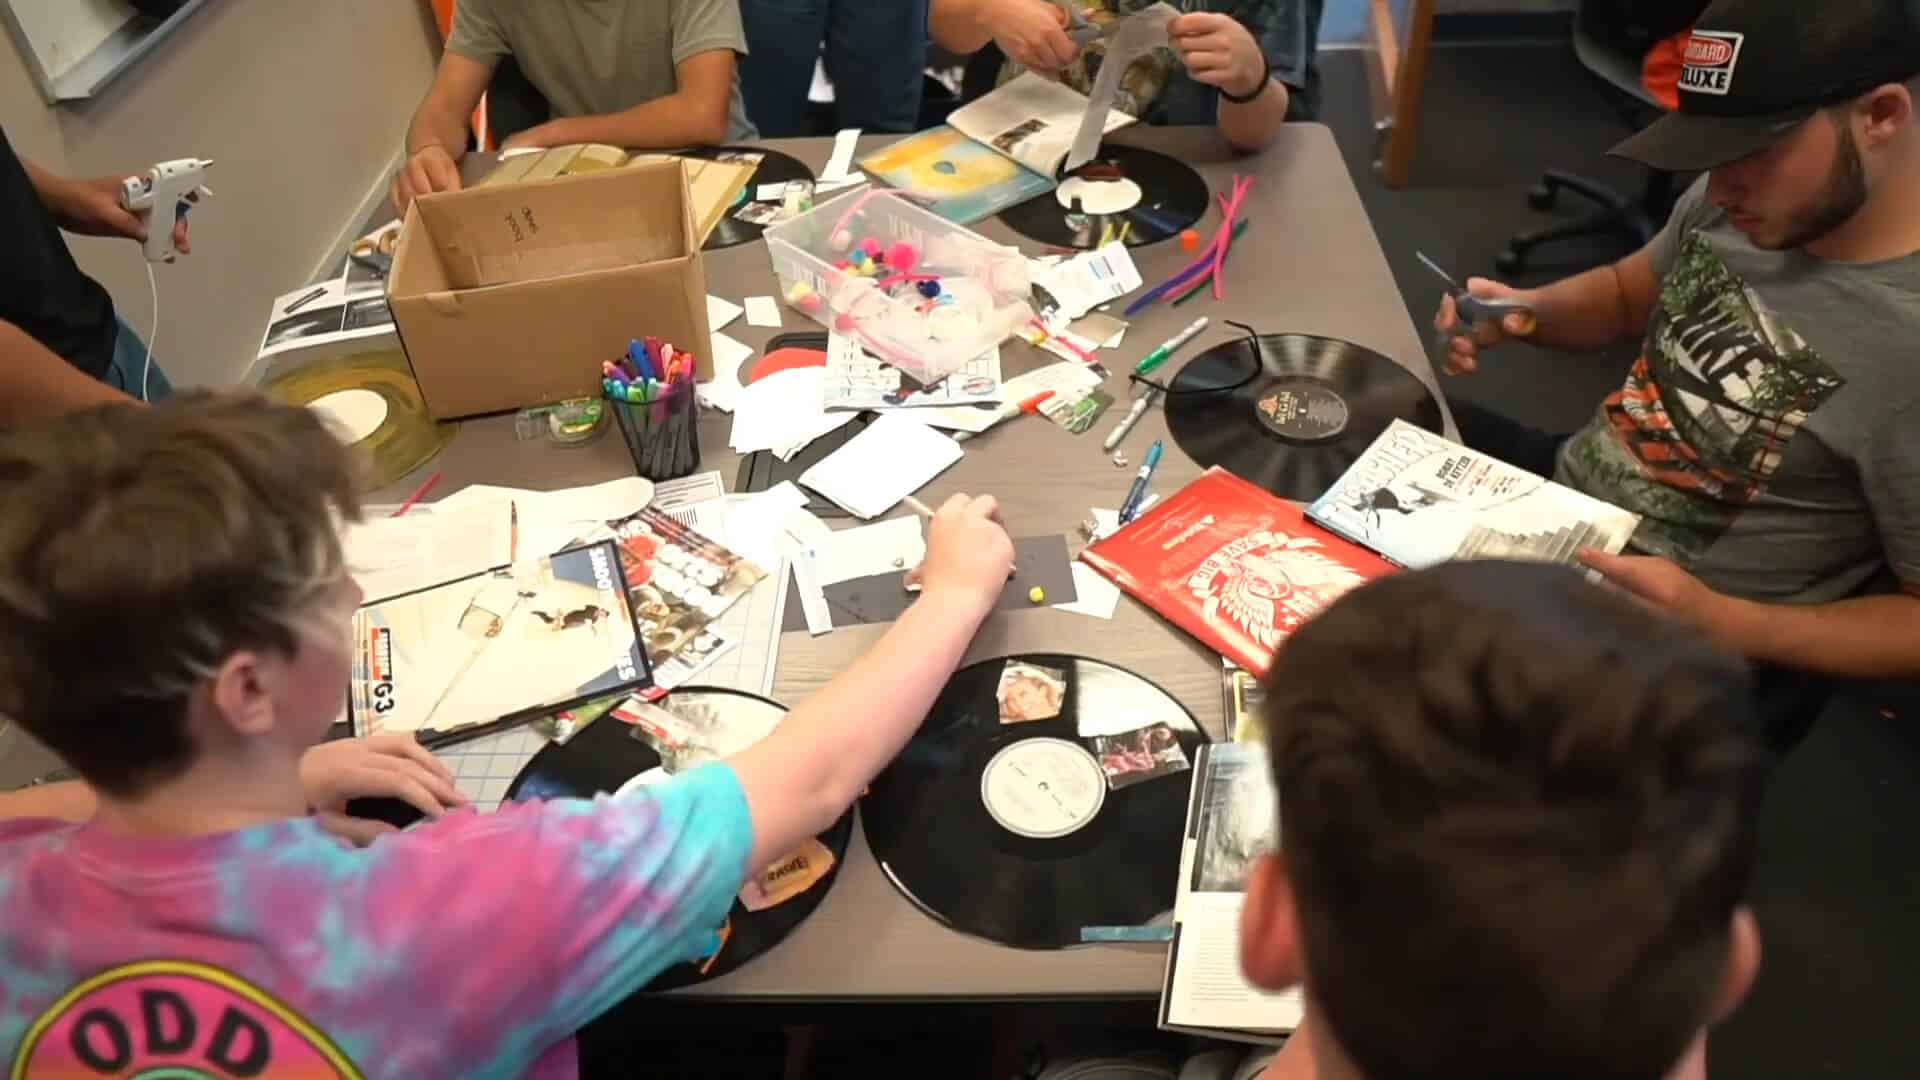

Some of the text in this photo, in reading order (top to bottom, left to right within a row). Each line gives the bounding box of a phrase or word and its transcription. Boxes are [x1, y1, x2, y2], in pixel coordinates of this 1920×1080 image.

[1681, 67, 1728, 88] LUXE
[1198, 557, 1221, 580] BIG
[374, 683, 394, 714] G3
[69, 988, 272, 1079] ODD
